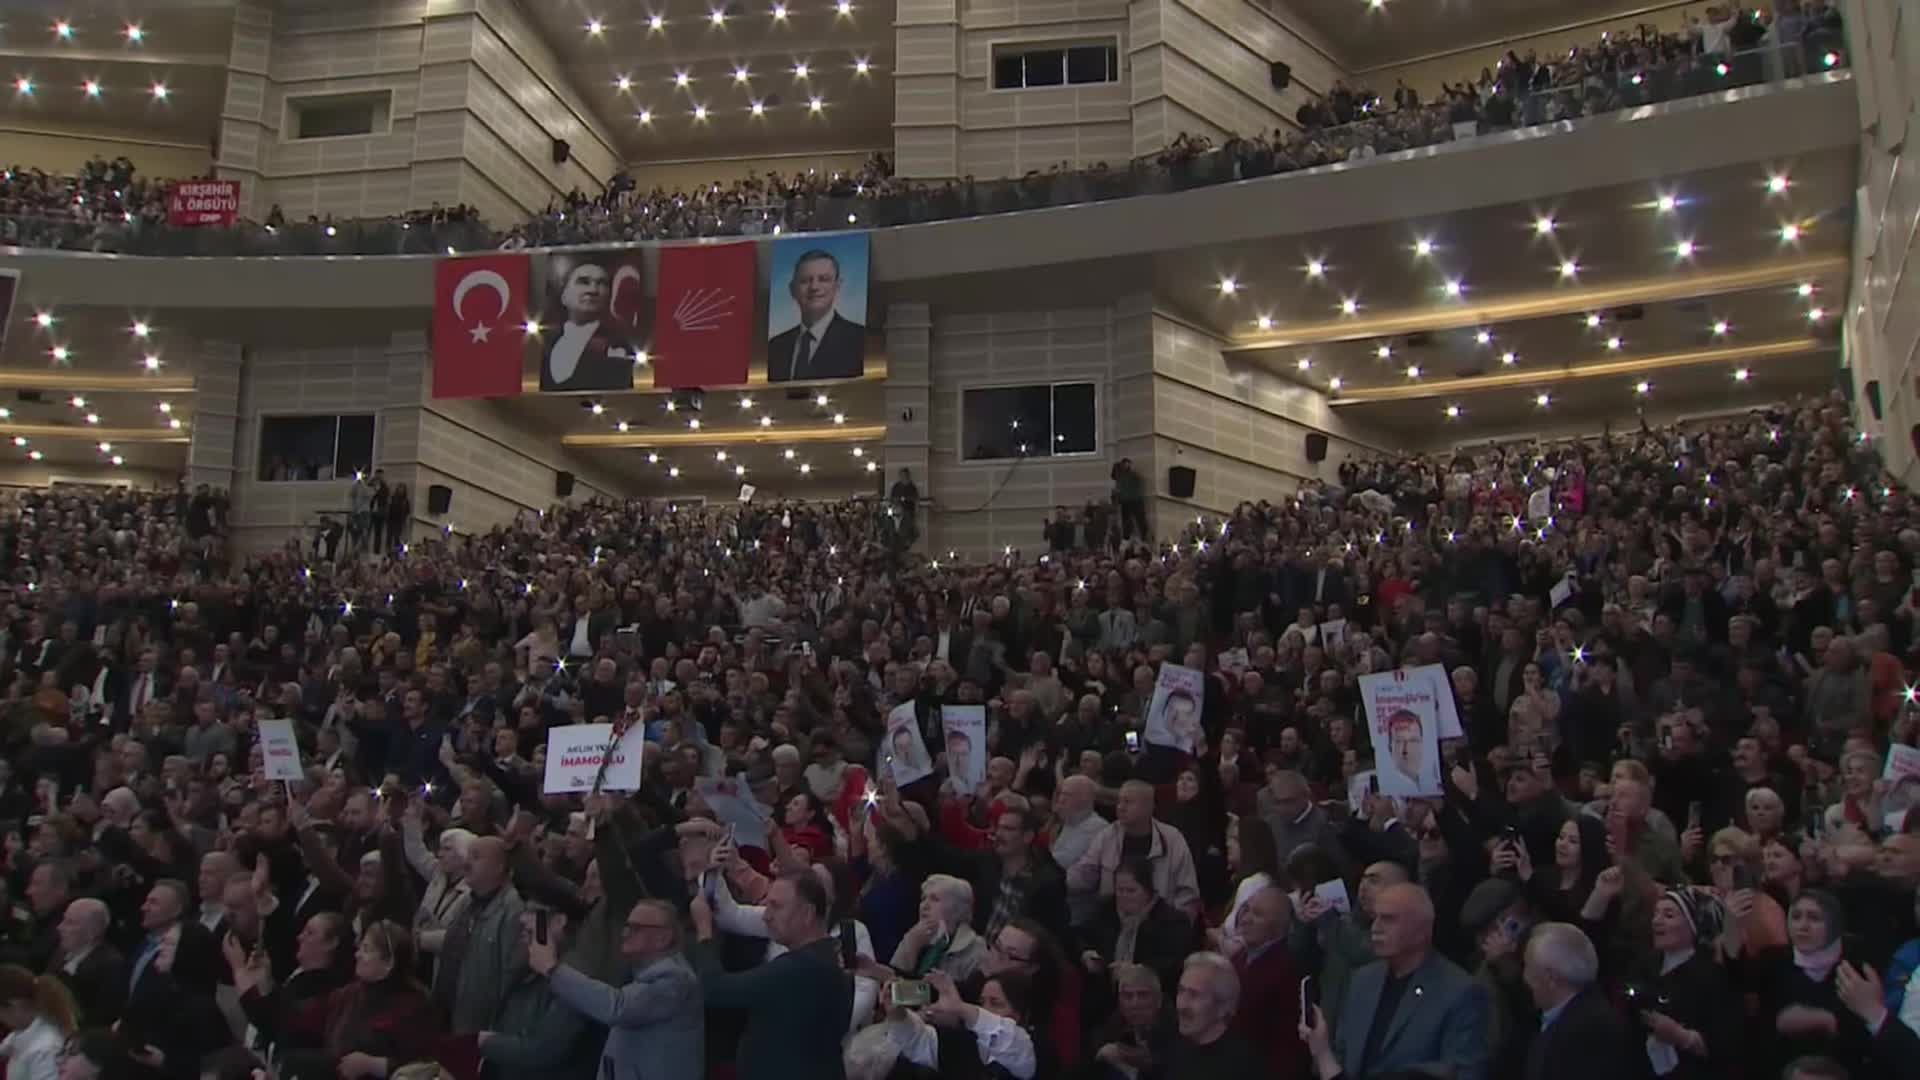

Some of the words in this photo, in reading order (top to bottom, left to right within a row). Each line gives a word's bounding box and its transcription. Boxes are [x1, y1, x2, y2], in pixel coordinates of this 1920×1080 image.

[180, 181, 233, 198] KIRŞEHİR
[174, 196, 183, 211] İL
[187, 196, 237, 211] ÖRGÜTÜ
